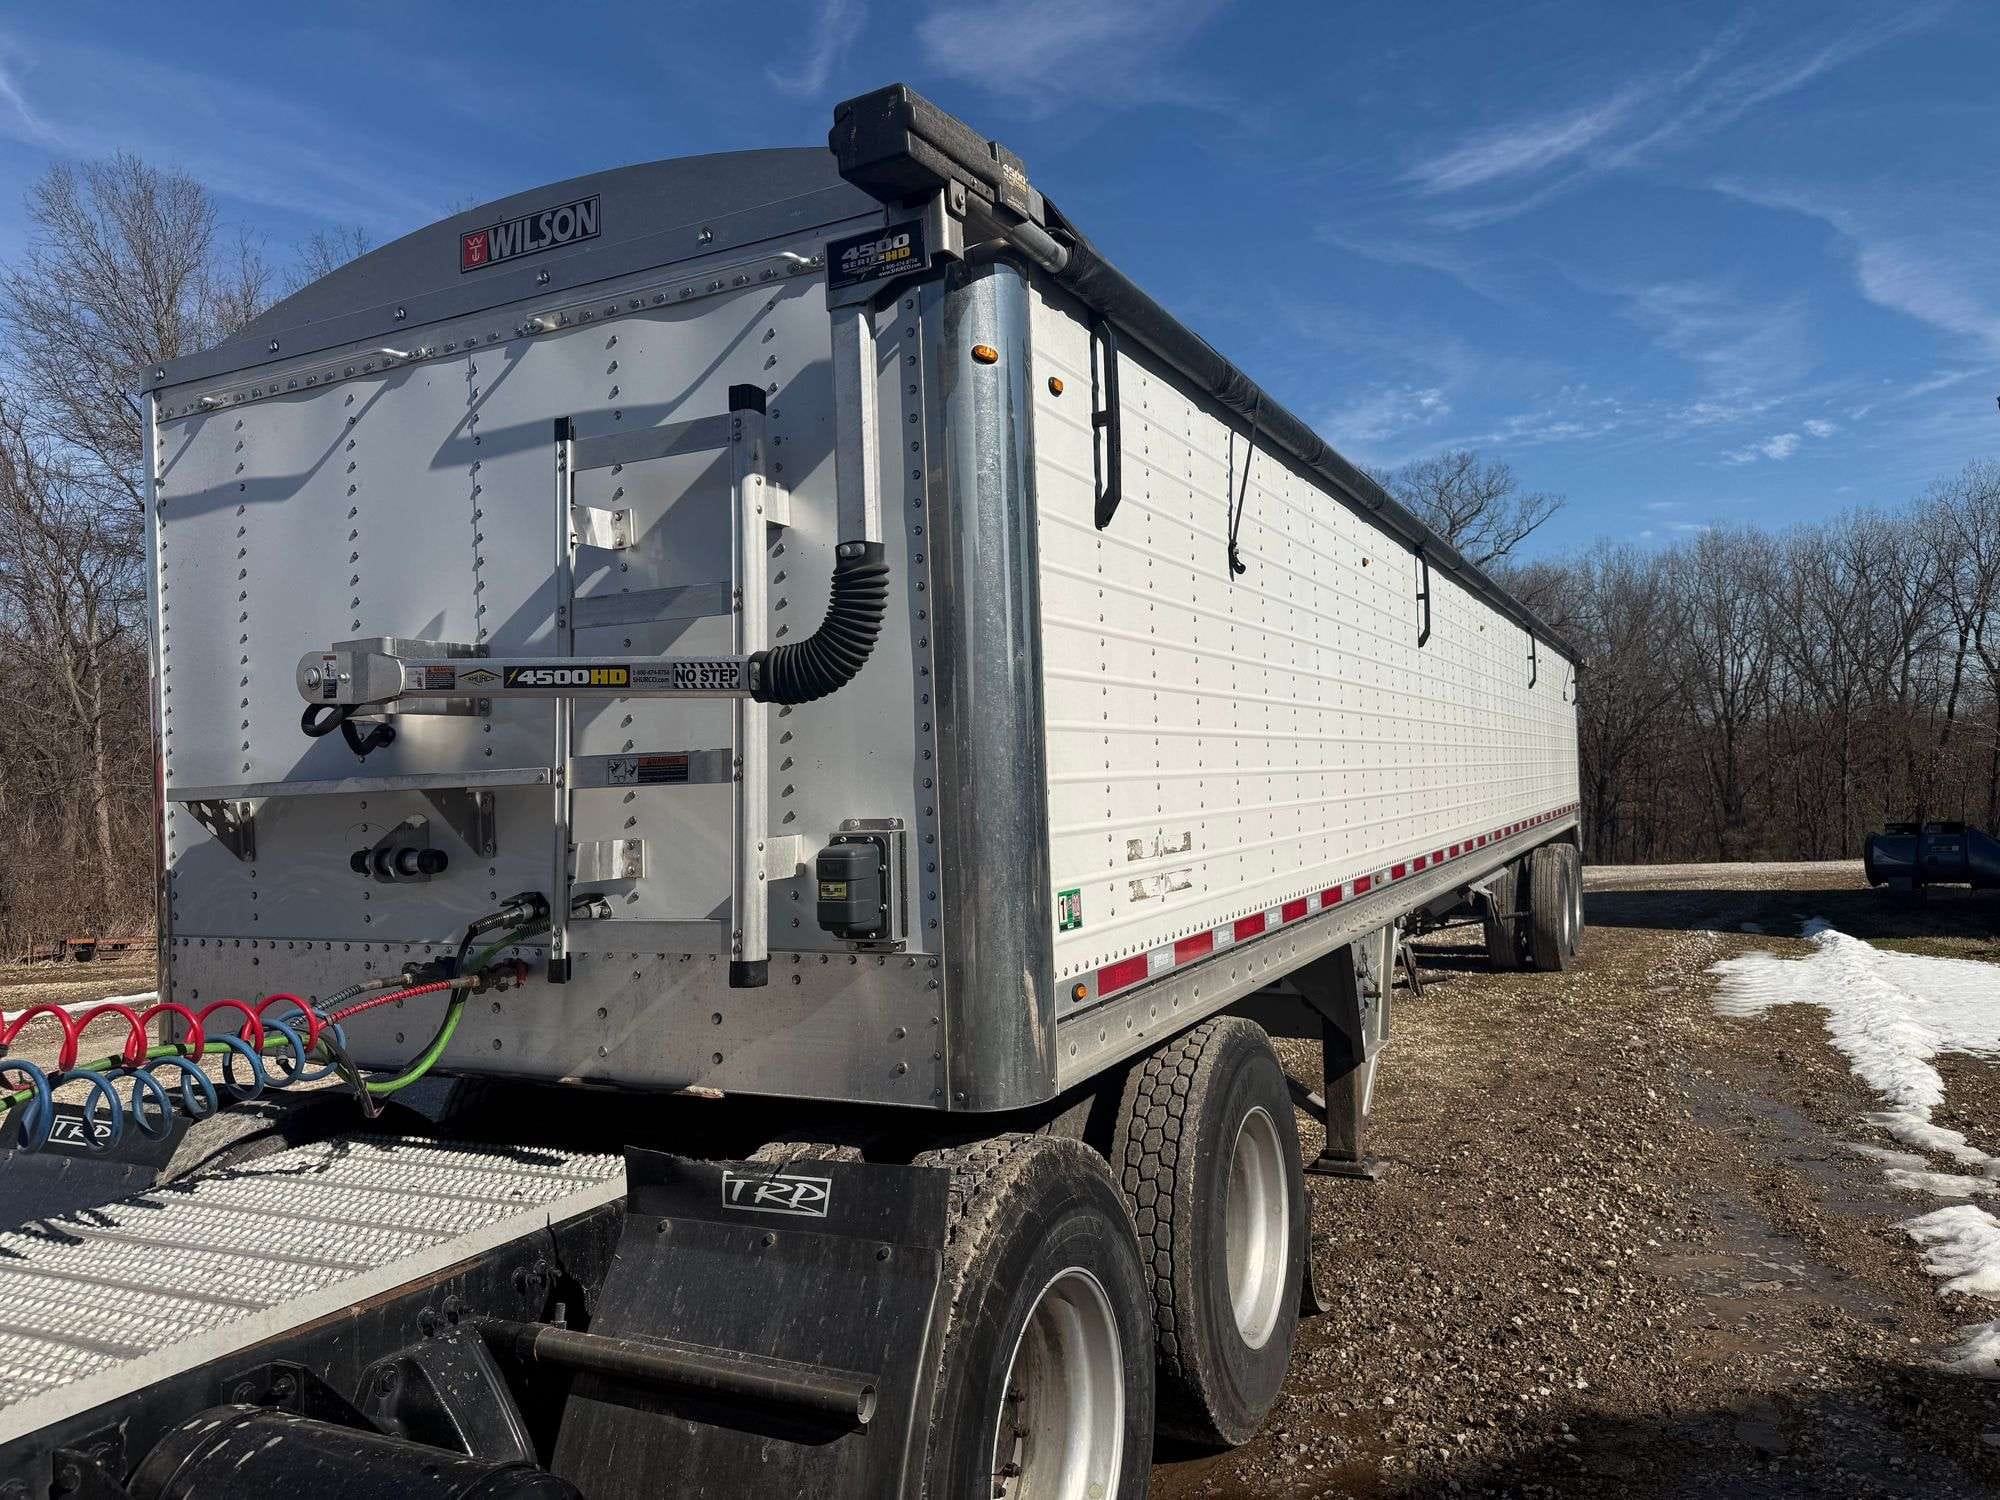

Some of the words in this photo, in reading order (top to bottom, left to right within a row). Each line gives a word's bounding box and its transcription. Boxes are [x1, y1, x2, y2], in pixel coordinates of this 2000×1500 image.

[488, 199, 597, 261] WILSON
[841, 233, 910, 260] 4500
[885, 246, 911, 262] HD
[518, 669, 628, 685] 4500HD
[675, 669, 697, 683] NO
[700, 668, 738, 683] STEP
